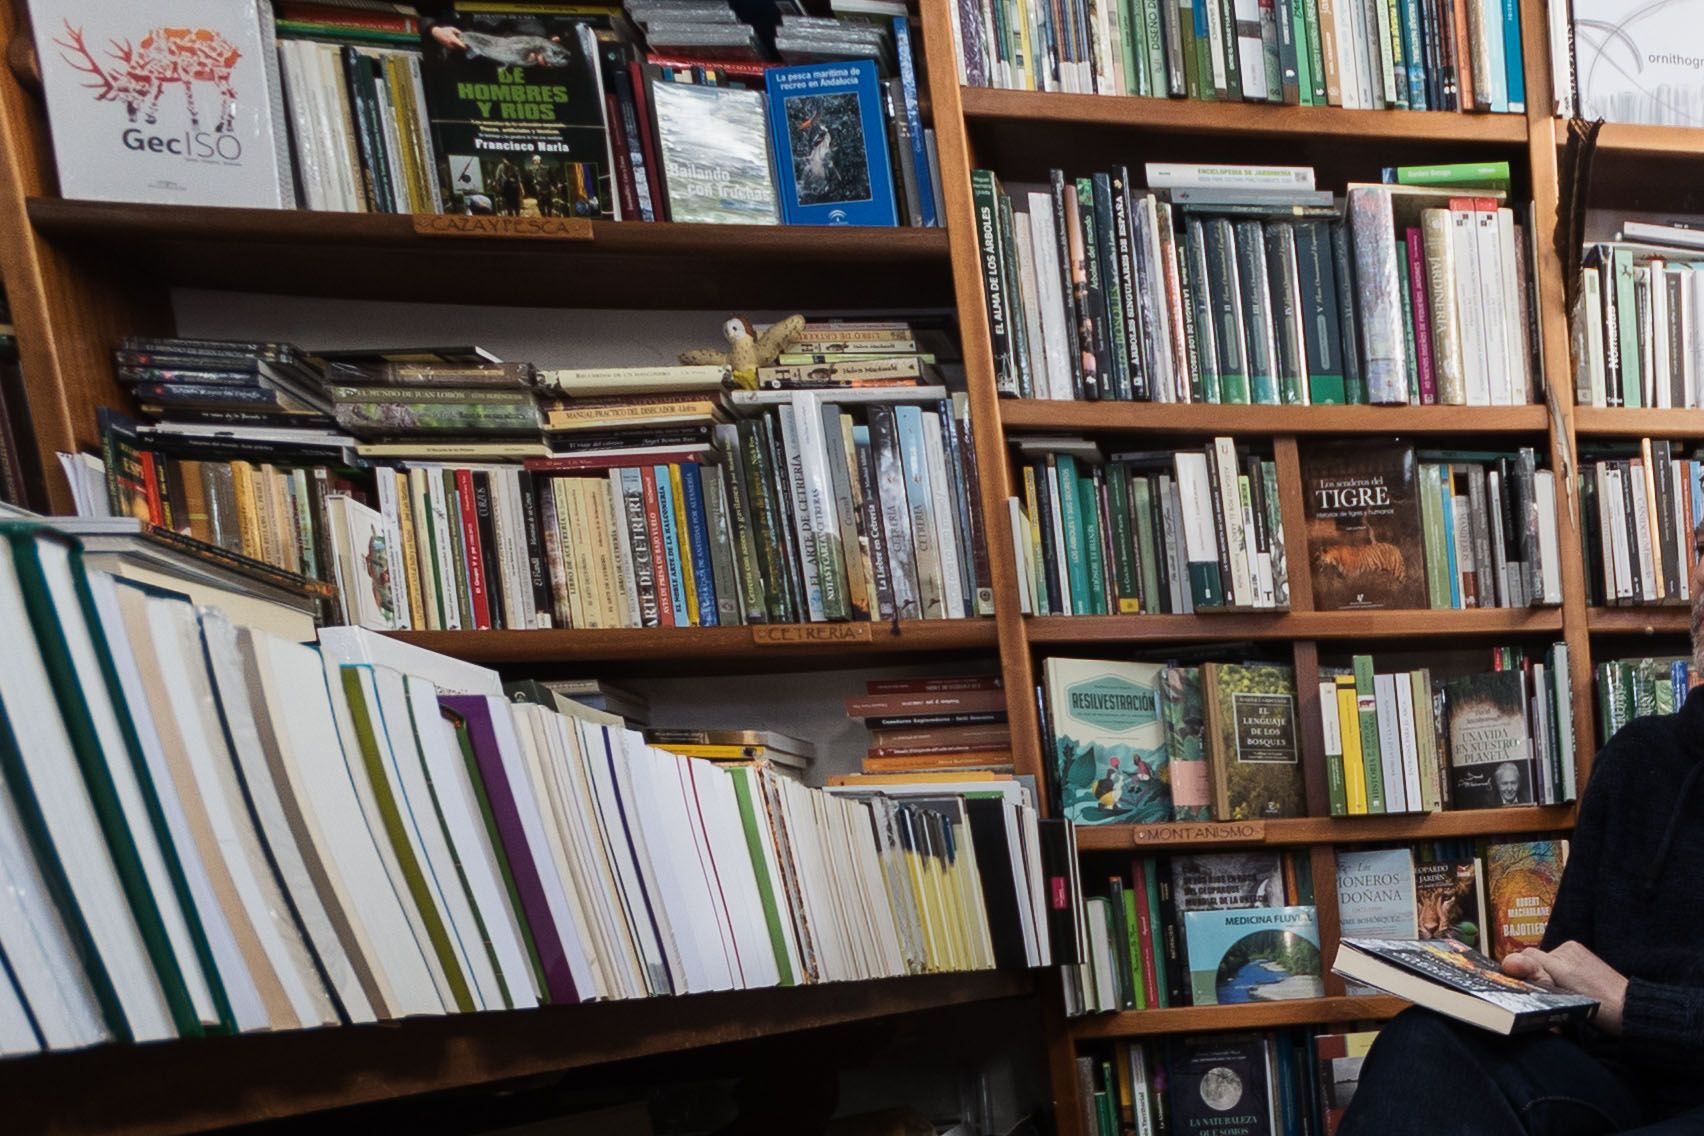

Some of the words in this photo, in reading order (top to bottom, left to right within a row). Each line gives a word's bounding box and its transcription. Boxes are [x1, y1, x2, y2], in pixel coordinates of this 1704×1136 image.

[498, 66, 524, 83] DE
[776, 73, 787, 83] La
[788, 72, 811, 83] pesca
[457, 83, 568, 103] HOMBRES
[780, 81, 807, 91] recreo
[476, 102, 492, 118] Y
[122, 128, 243, 160] GecISO
[474, 138, 534, 150] Francisco
[671, 162, 729, 180] Bailando
[688, 182, 715, 195] con
[1114, 195, 1127, 236] ESPAÑA
[980, 206, 995, 253] ÁRBOLES
[1119, 238, 1128, 252] DE
[987, 254, 998, 274] LOS
[989, 274, 1000, 291] DE
[1121, 255, 1135, 317] SINGULARES
[990, 291, 1004, 321] ALMA
[995, 323, 1005, 336] EL
[1127, 319, 1139, 365] ÁRBOLES
[1320, 479, 1334, 489] Los
[1336, 478, 1369, 487] senderos
[1371, 476, 1383, 485] del
[1316, 486, 1390, 509] TIGRE
[802, 515, 812, 531] DE
[868, 504, 879, 538] Cetrería
[804, 535, 818, 565] ARTE
[873, 539, 881, 550] en
[669, 558, 677, 577] ARTE
[876, 552, 885, 579] Liebre
[637, 567, 652, 586] DE
[810, 575, 820, 587] EL
[879, 580, 888, 591] La
[642, 590, 659, 628] ARTE
[1072, 692, 1156, 711] RESILVESTRACIÓN
[1259, 707, 1270, 716] EL
[1242, 716, 1286, 726] LENGUAJE
[1250, 727, 1262, 736] DE
[1263, 727, 1281, 736] LOS
[1483, 728, 1508, 741] VIDA
[1247, 737, 1286, 747] BOSQUES
[1464, 749, 1510, 764] PLANETA
[1146, 825, 1254, 841] MONTAÑISMO
[1225, 916, 1272, 925] MEDICINA
[1201, 1115, 1258, 1127] NATURALEZA
[1218, 1128, 1249, 1136] SOMOS
